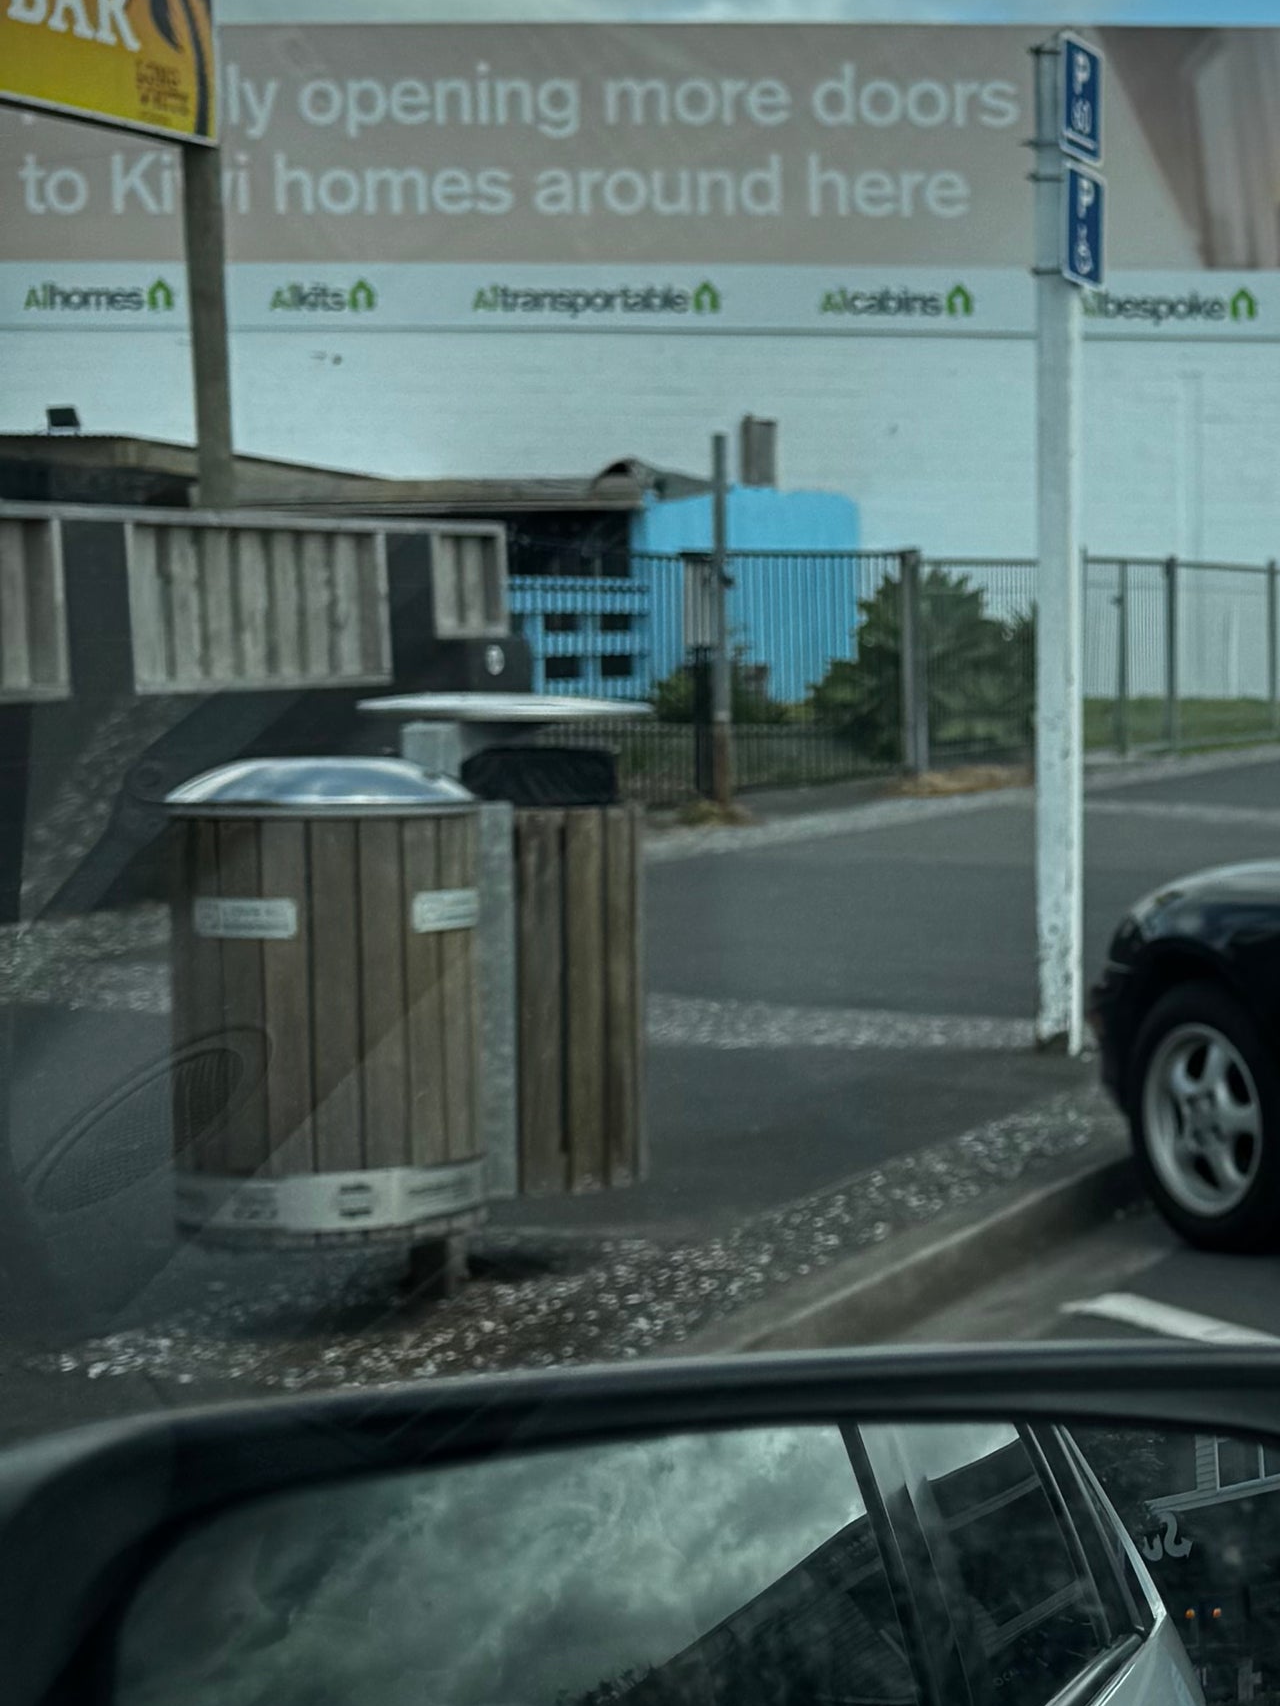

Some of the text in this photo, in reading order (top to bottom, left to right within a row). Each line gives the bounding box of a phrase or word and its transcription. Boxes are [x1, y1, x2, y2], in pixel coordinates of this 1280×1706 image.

[299, 61, 579, 139] opening
[603, 78, 792, 127] more
[811, 61, 1021, 128] doors
[19, 152, 971, 218] to Kii homes around here
